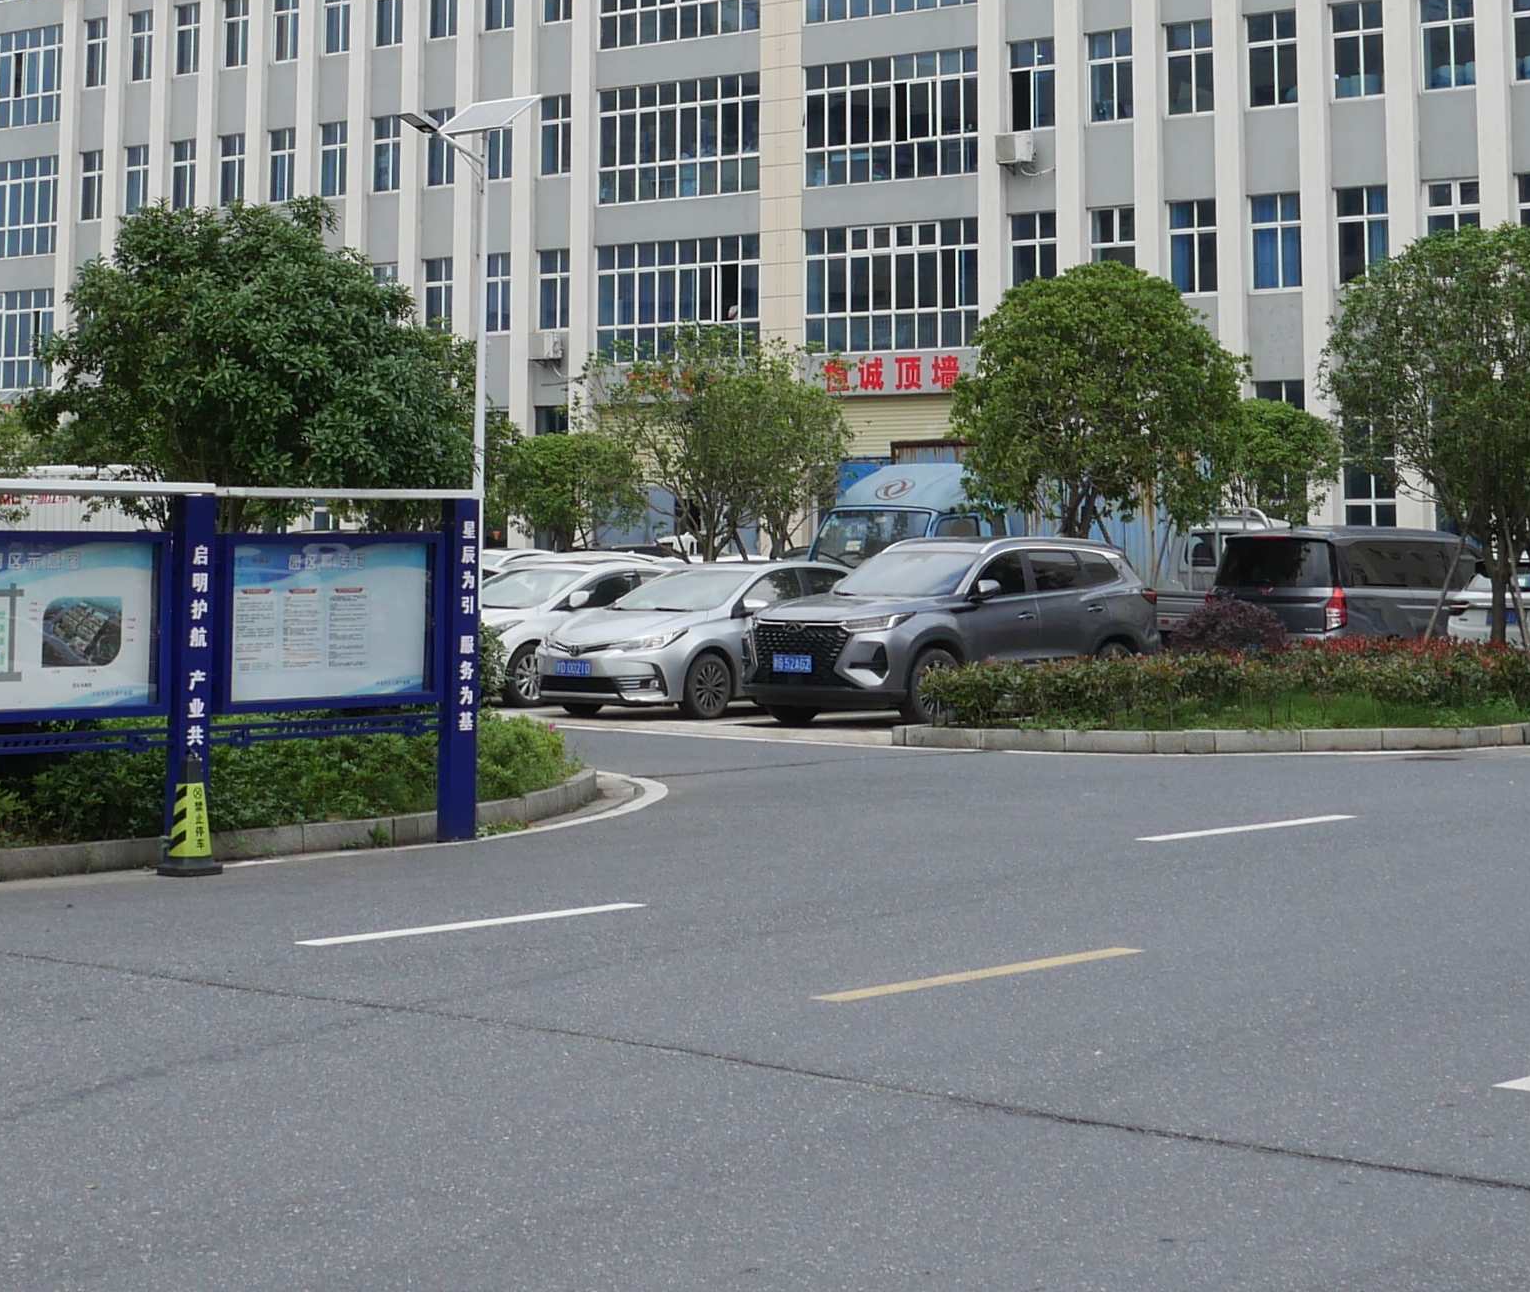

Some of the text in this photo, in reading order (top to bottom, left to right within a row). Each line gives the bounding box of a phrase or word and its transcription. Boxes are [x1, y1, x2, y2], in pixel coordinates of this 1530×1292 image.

[186, 544, 208, 763] 启明护航 产业共
[458, 520, 476, 732] 星辰为引 服务为基
[194, 801, 205, 850] 禁止停车
